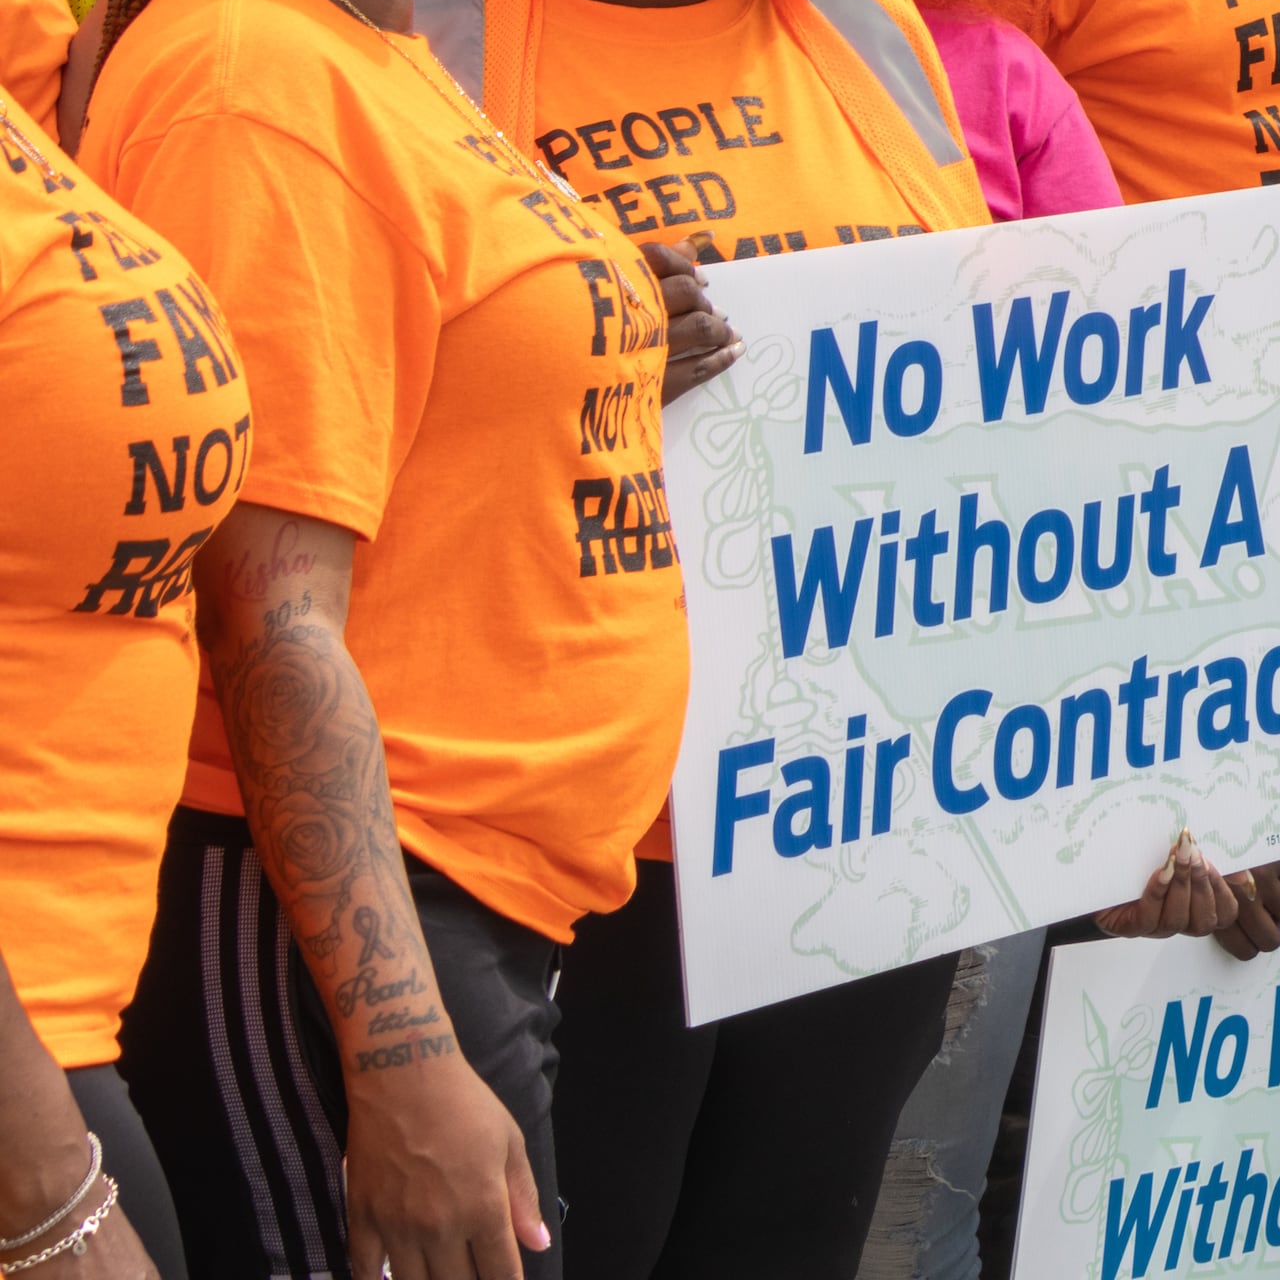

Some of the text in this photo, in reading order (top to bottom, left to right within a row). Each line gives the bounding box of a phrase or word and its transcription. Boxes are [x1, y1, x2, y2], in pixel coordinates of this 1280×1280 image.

[535, 95, 783, 181] PEOPLE
[804, 268, 1214, 454] No Work
[124, 413, 250, 517] NOT
[581, 382, 634, 455] NOT
[771, 445, 1265, 659] Without A
[712, 714, 911, 877] Fair
[336, 967, 427, 1018] Pearl
[1145, 995, 1249, 1110] No
